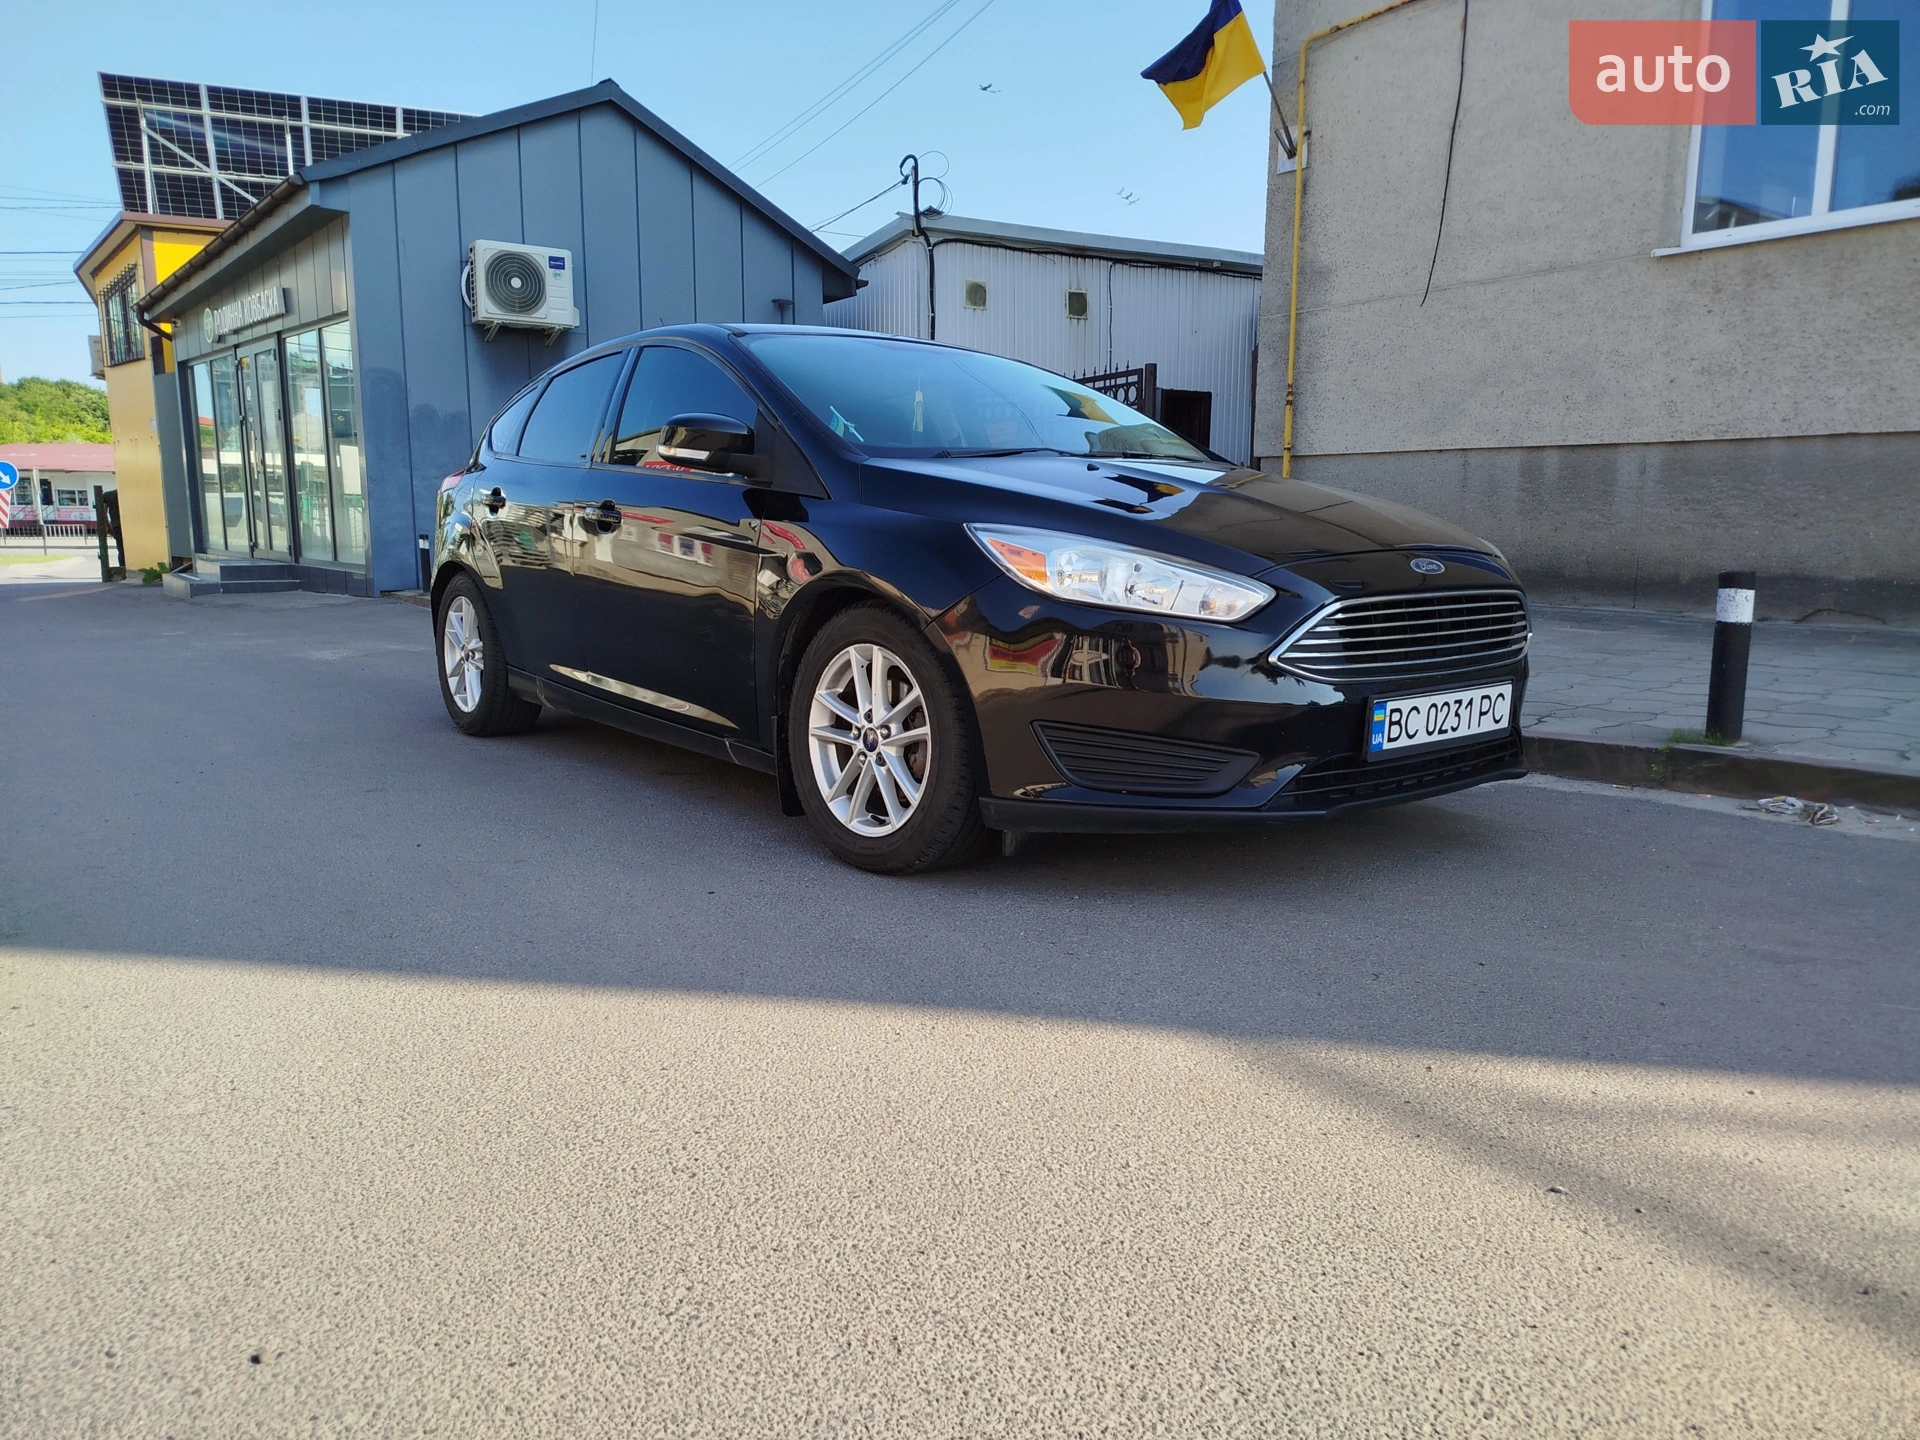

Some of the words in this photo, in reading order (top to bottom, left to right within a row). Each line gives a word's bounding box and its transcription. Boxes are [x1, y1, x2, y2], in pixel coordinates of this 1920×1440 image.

[213, 300, 244, 336] РОДИННА
[243, 286, 280, 327] КОВБАСКА
[1372, 732, 1383, 745] UA
[1386, 705, 1421, 743] BC
[1425, 697, 1474, 737] 0231
[1477, 692, 1506, 729] PC
